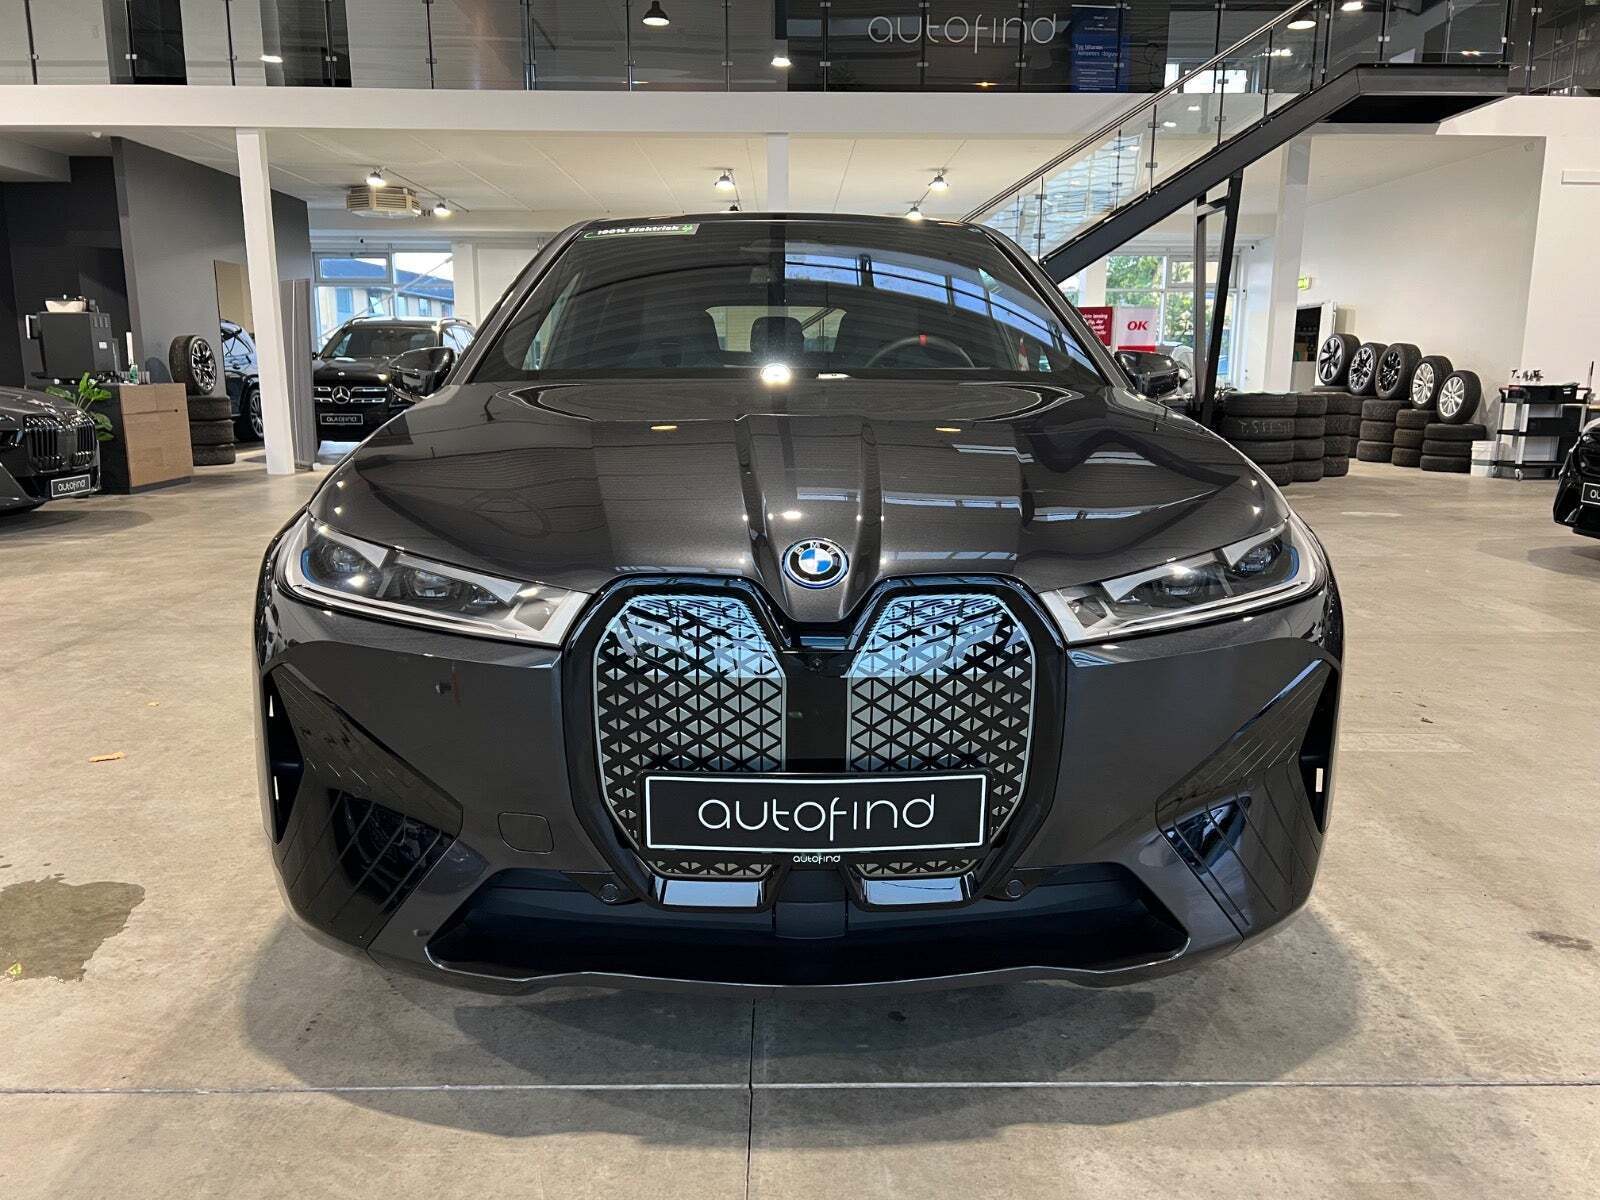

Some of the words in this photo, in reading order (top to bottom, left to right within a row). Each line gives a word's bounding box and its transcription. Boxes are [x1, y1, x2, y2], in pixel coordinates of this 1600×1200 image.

[868, 13, 1056, 54] autofind
[1127, 320, 1149, 331] OK
[698, 793, 935, 841] autofind
[792, 854, 841, 865] autofind
